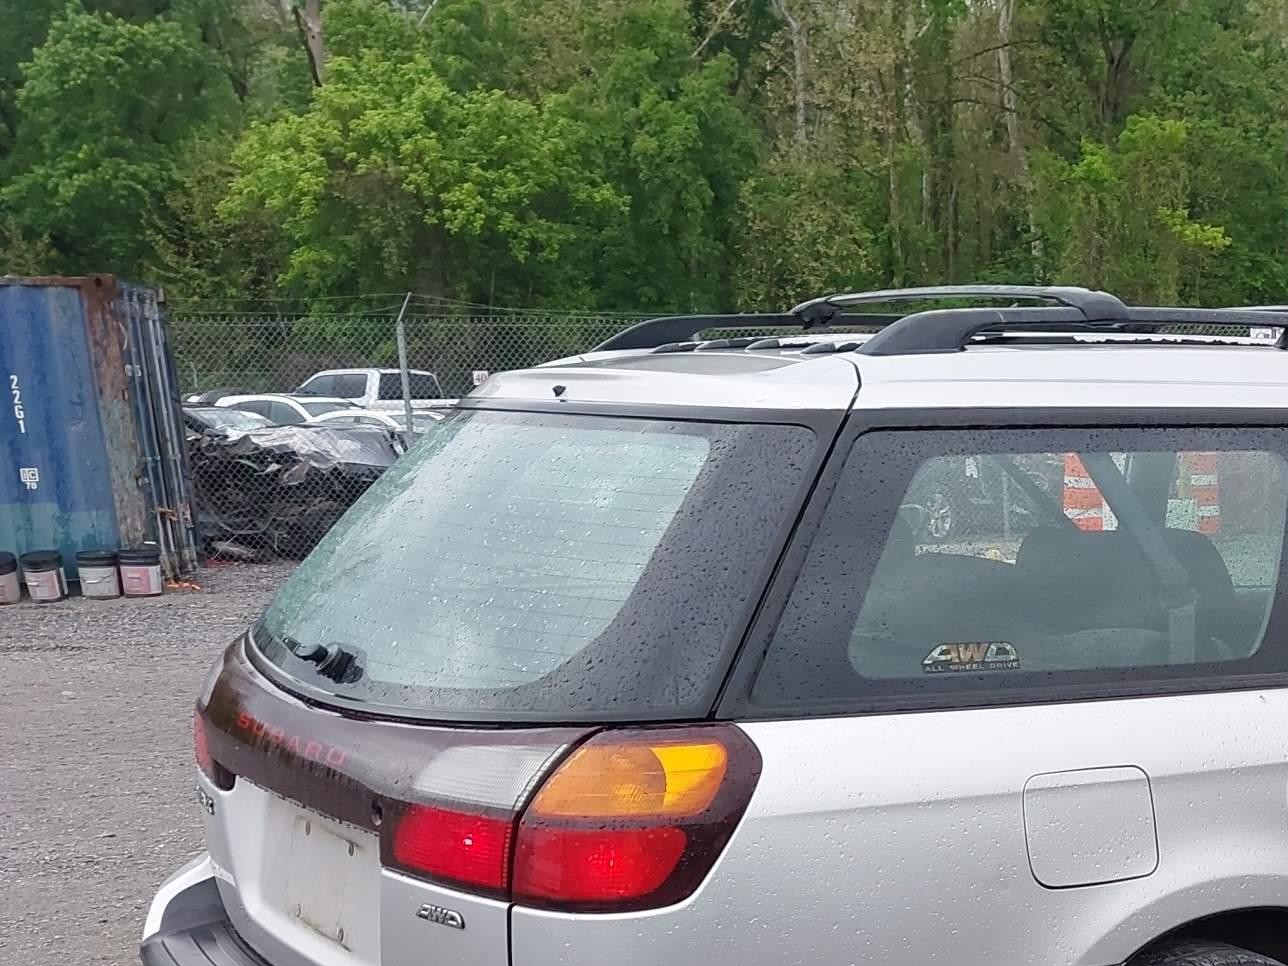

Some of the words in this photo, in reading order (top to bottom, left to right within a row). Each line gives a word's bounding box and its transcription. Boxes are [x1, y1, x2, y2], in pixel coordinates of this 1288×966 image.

[9, 374, 26, 434] 22G1
[922, 642, 1018, 664] AWD
[949, 663, 985, 671] WHEEL
[236, 710, 348, 767] SUBARU
[416, 903, 466, 930] AWD
